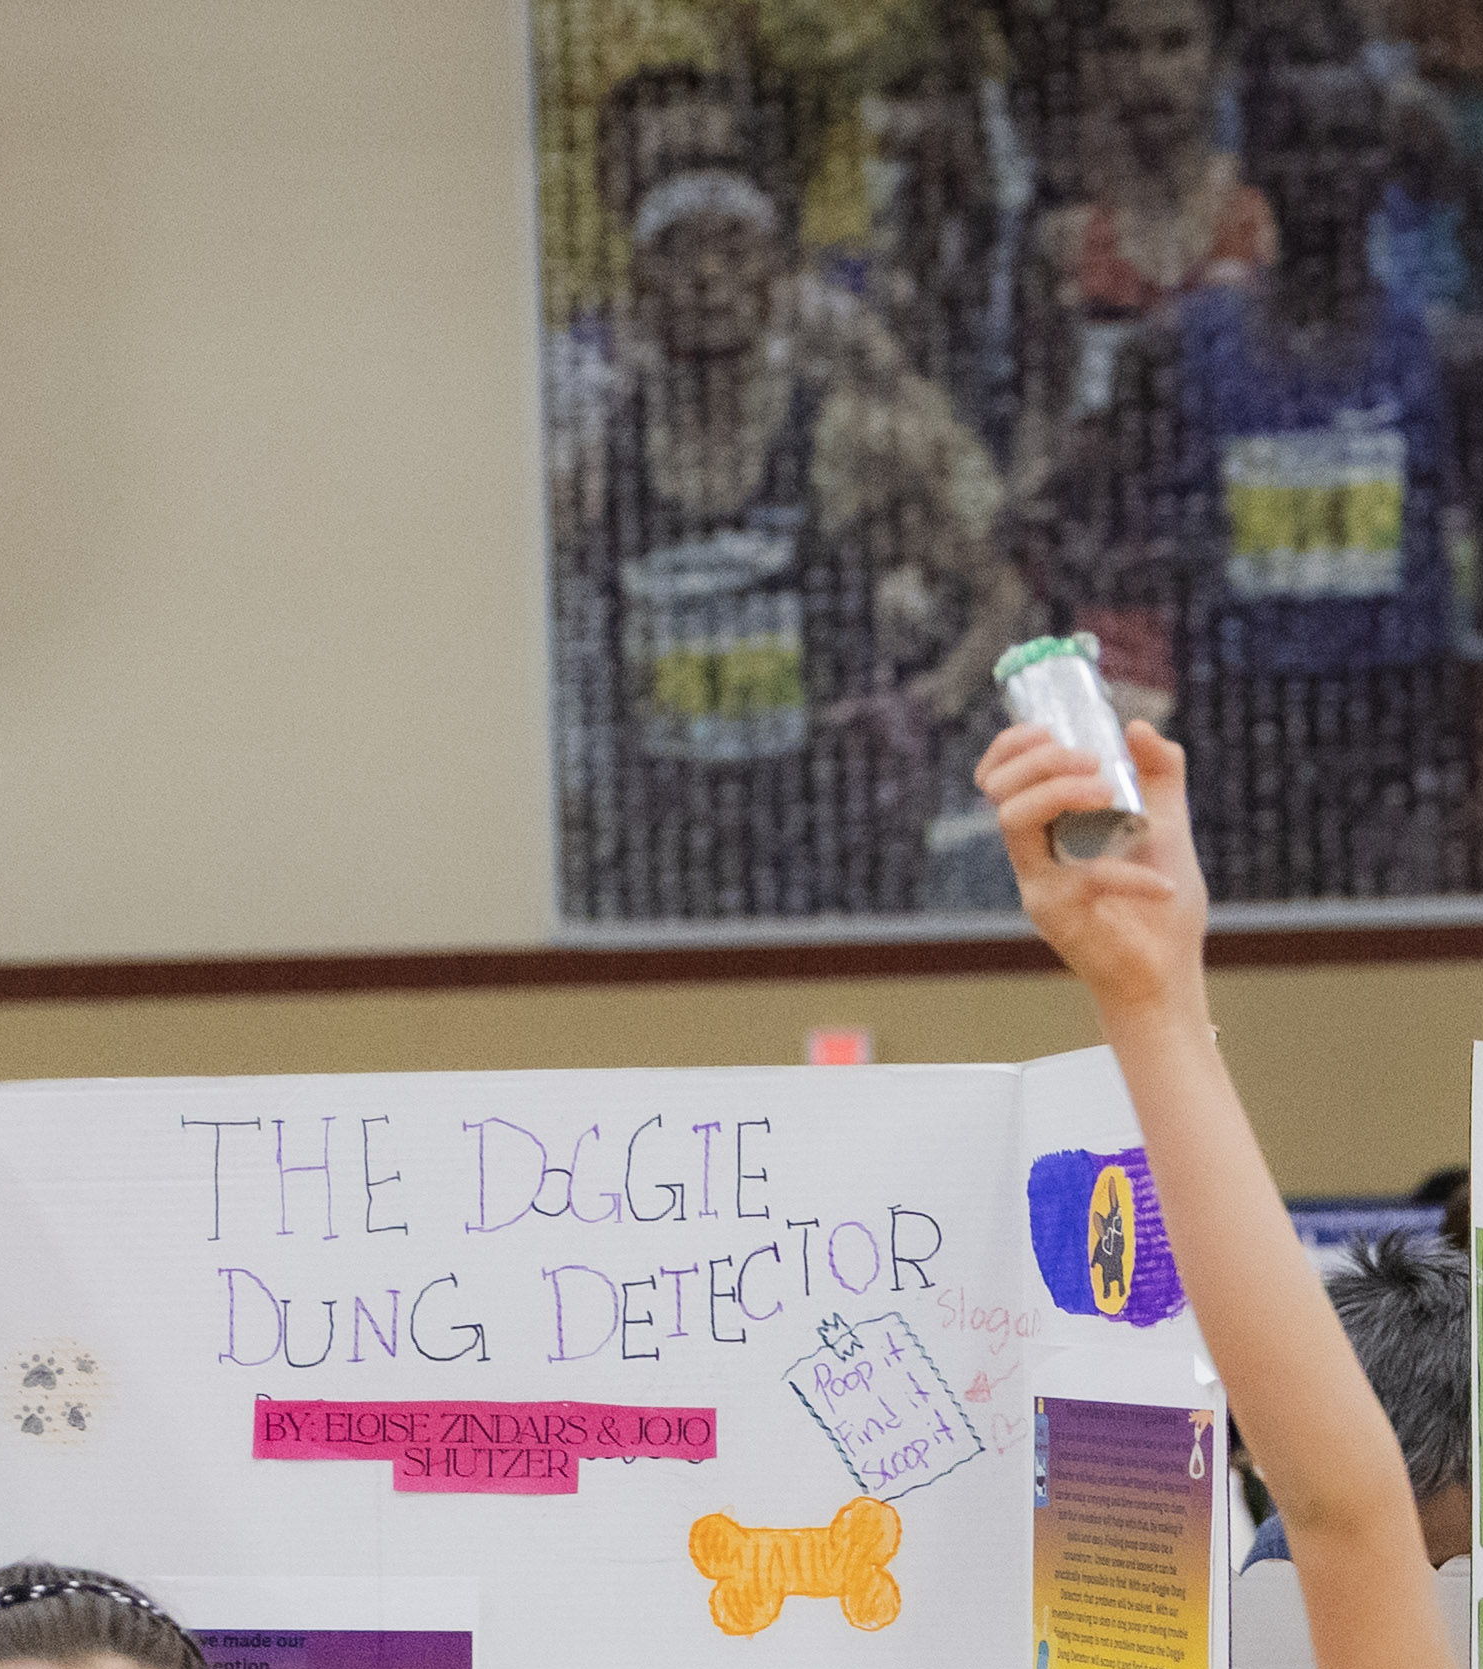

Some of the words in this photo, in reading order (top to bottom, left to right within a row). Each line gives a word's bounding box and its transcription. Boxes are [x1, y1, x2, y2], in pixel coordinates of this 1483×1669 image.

[181, 1113, 408, 1241] THE
[218, 1266, 491, 1369] DUNG
[542, 1206, 942, 1363] DETECTOR
[884, 1331, 905, 1368] it
[906, 1371, 930, 1408] it
[325, 1412, 430, 1446] ELOISE
[440, 1412, 587, 1446] ZINDARS
[596, 1417, 627, 1447] &
[630, 1415, 712, 1448] JOJO
[402, 1446, 570, 1479] SHUTZER
[222, 1635, 274, 1648] made
[277, 1637, 307, 1648] our
